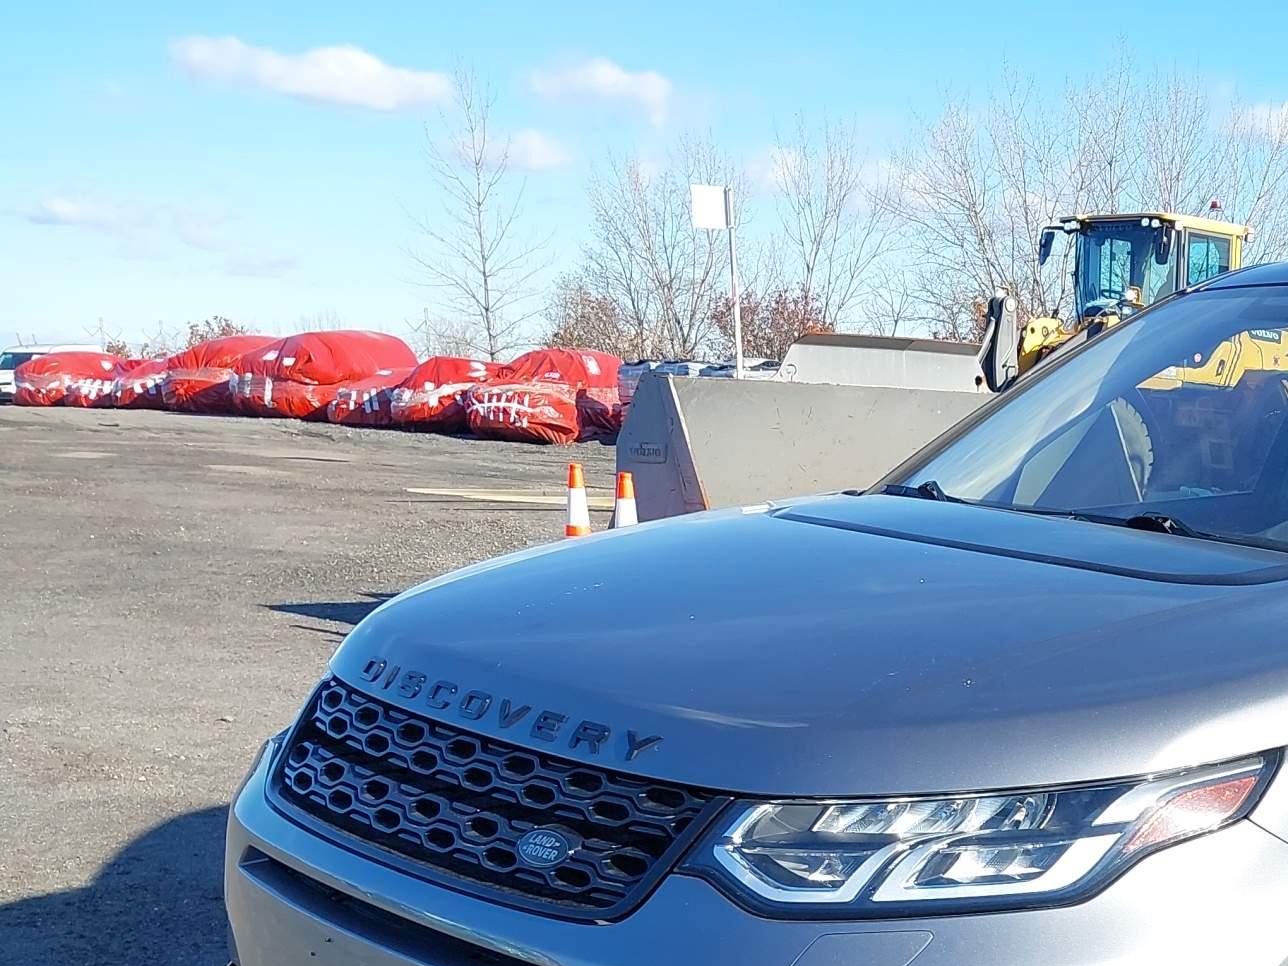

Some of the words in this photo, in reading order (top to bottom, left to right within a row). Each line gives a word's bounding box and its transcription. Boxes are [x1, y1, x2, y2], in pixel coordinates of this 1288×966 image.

[359, 657, 665, 761] DISCOVERY
[528, 833, 556, 847] LAND
[525, 844, 558, 861] ROVER
